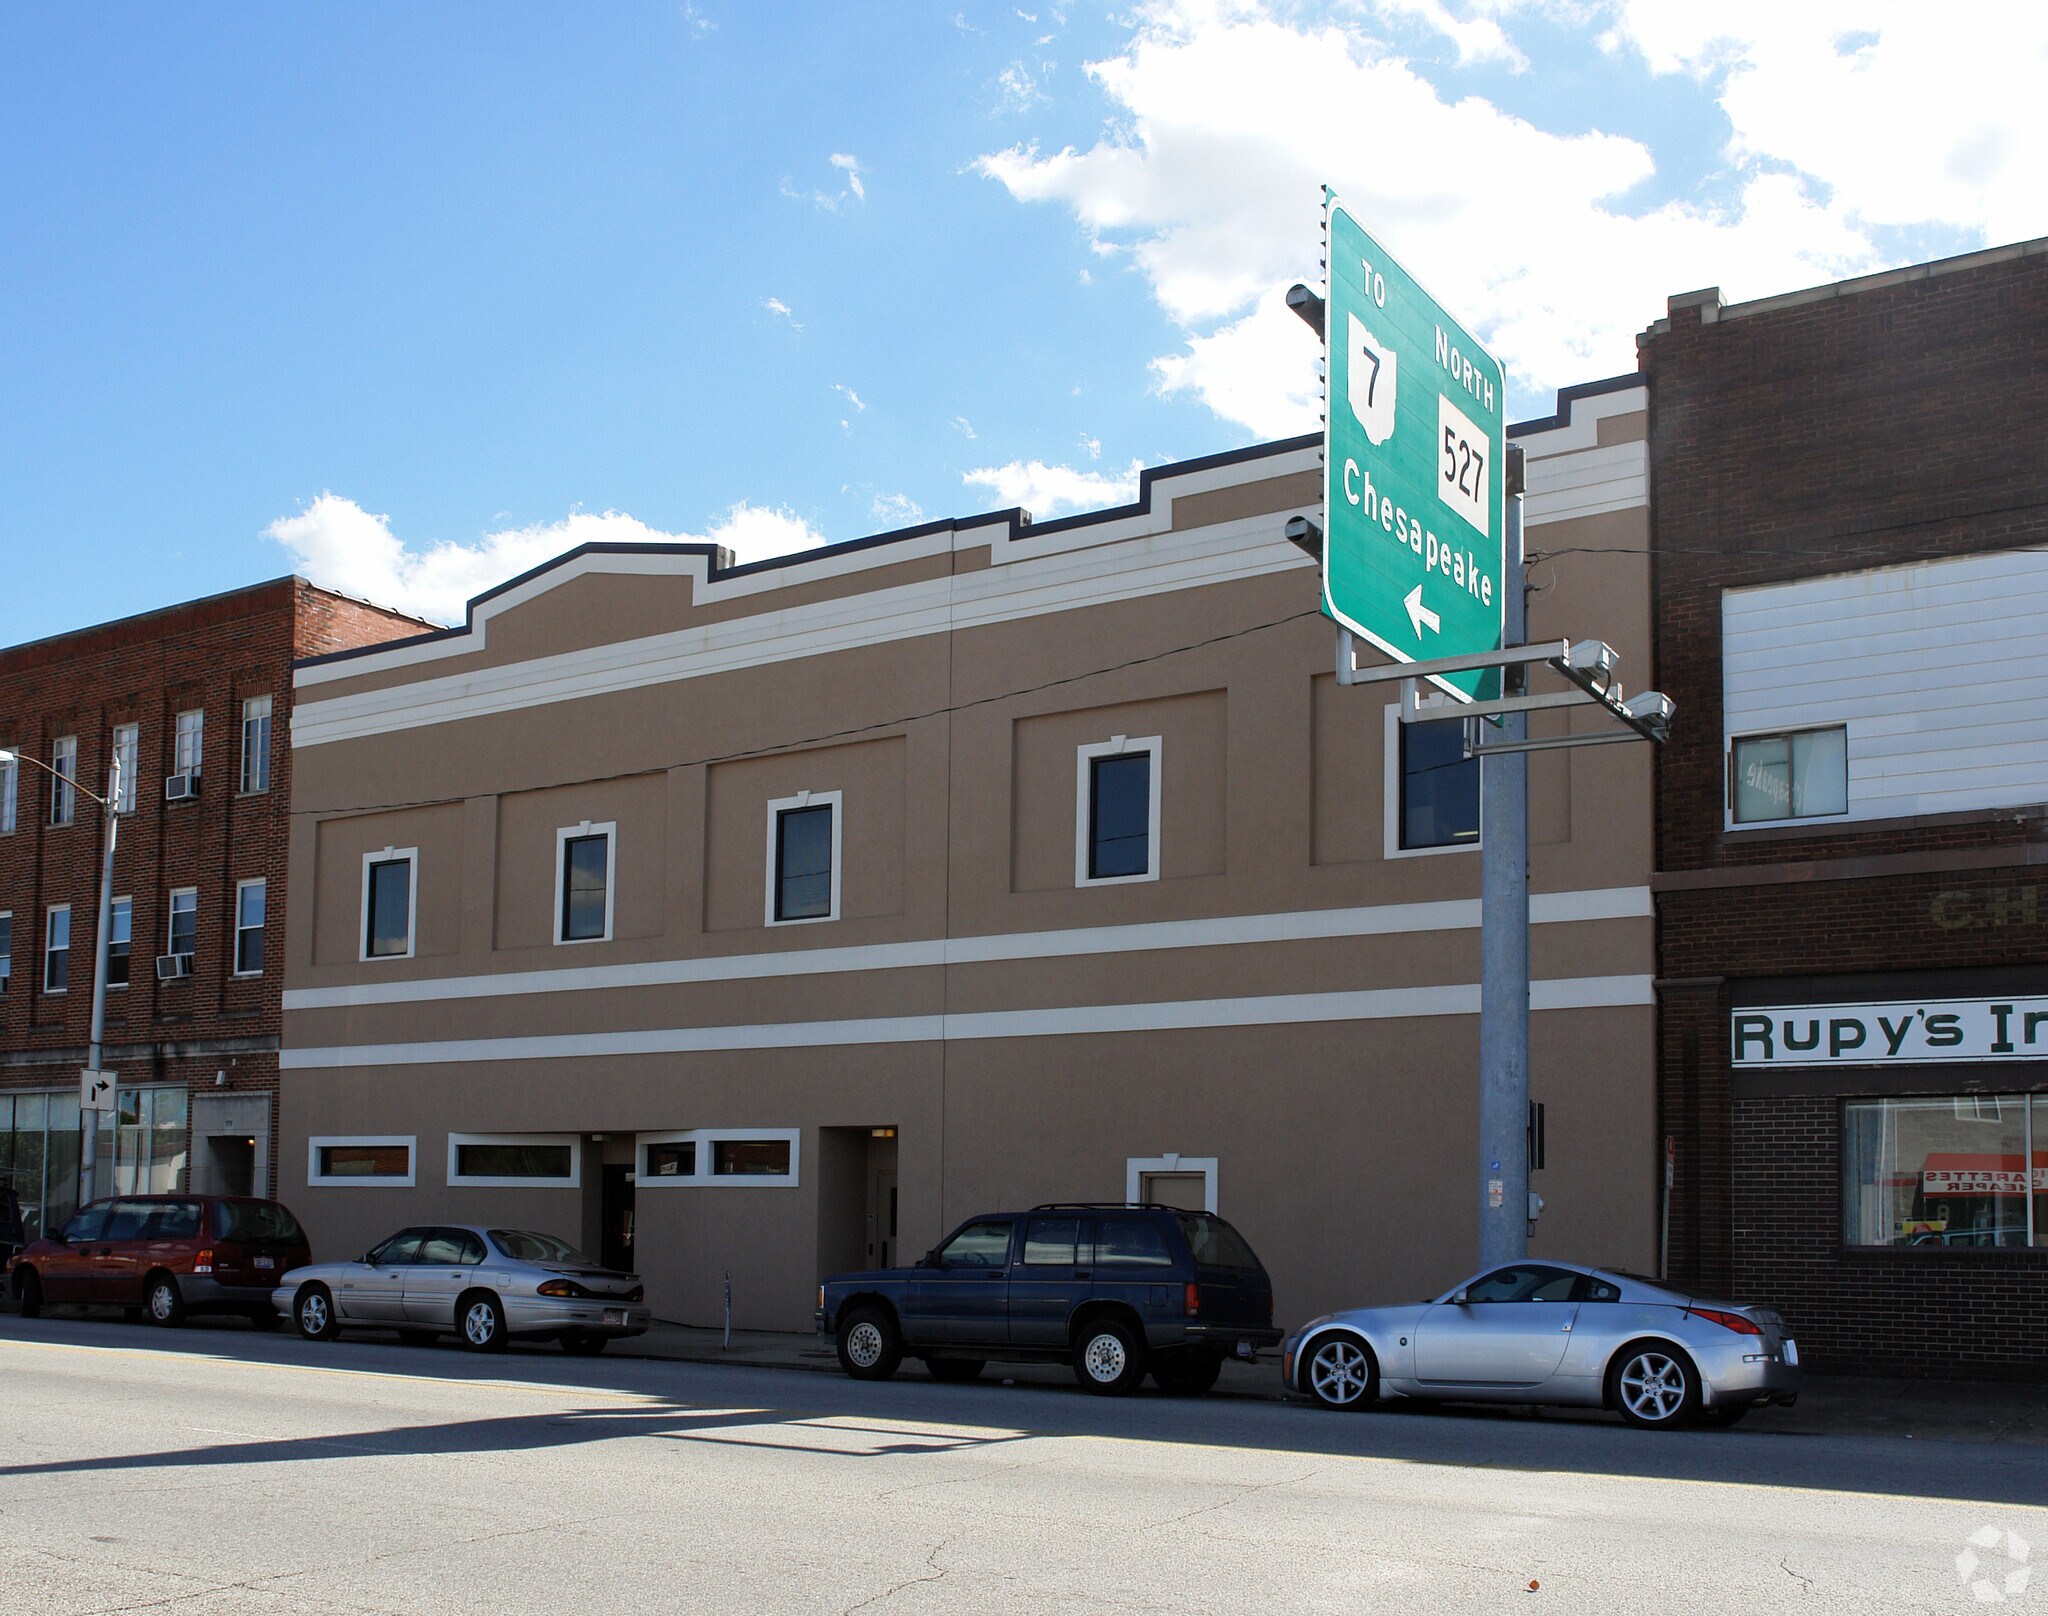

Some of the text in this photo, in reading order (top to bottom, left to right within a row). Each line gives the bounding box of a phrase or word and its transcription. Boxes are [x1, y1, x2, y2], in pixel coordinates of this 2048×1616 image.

[1361, 258, 1385, 308] TO
[1364, 346, 1379, 408] 7
[1435, 324, 1494, 413] NORTH
[1445, 425, 1483, 503] 527
[1344, 458, 1492, 607] Chesapeake
[1734, 1008, 1964, 1060] Rupy's
